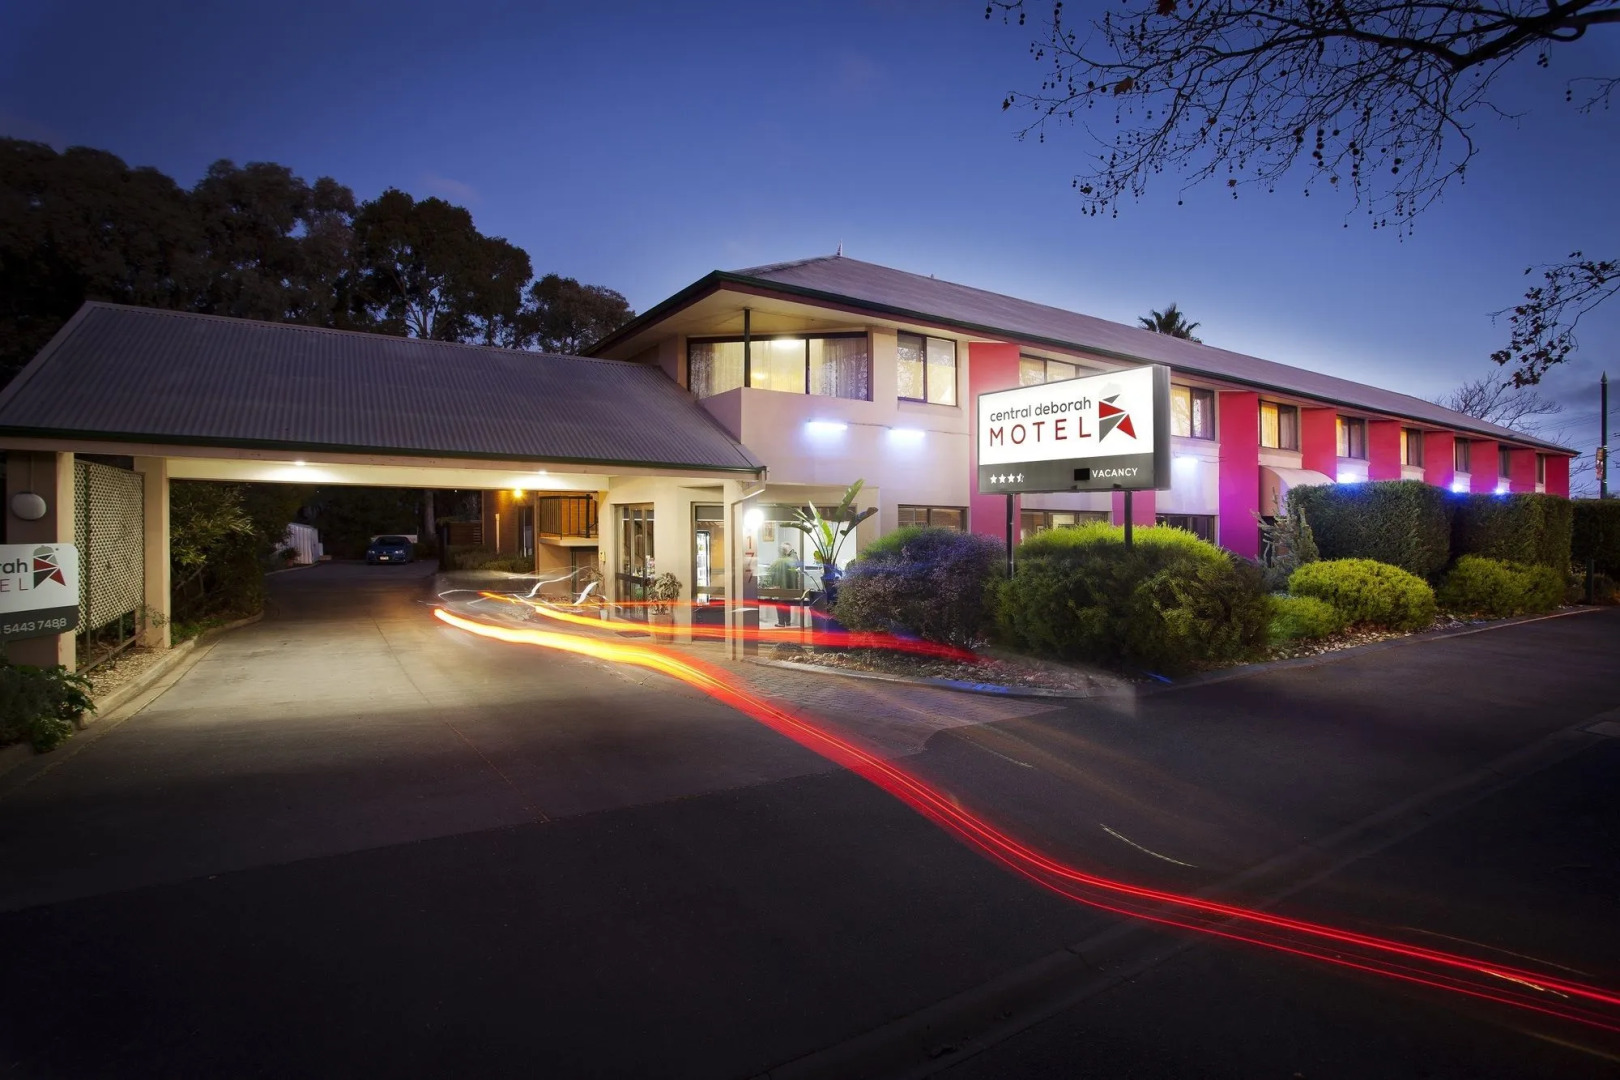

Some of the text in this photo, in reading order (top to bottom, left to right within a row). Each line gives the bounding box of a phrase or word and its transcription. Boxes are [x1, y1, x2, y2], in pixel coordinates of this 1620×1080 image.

[990, 396, 1092, 422] central deborah
[989, 416, 1092, 447] MOTEL
[1092, 467, 1139, 479] VACANCY
[0, 558, 28, 574] ah
